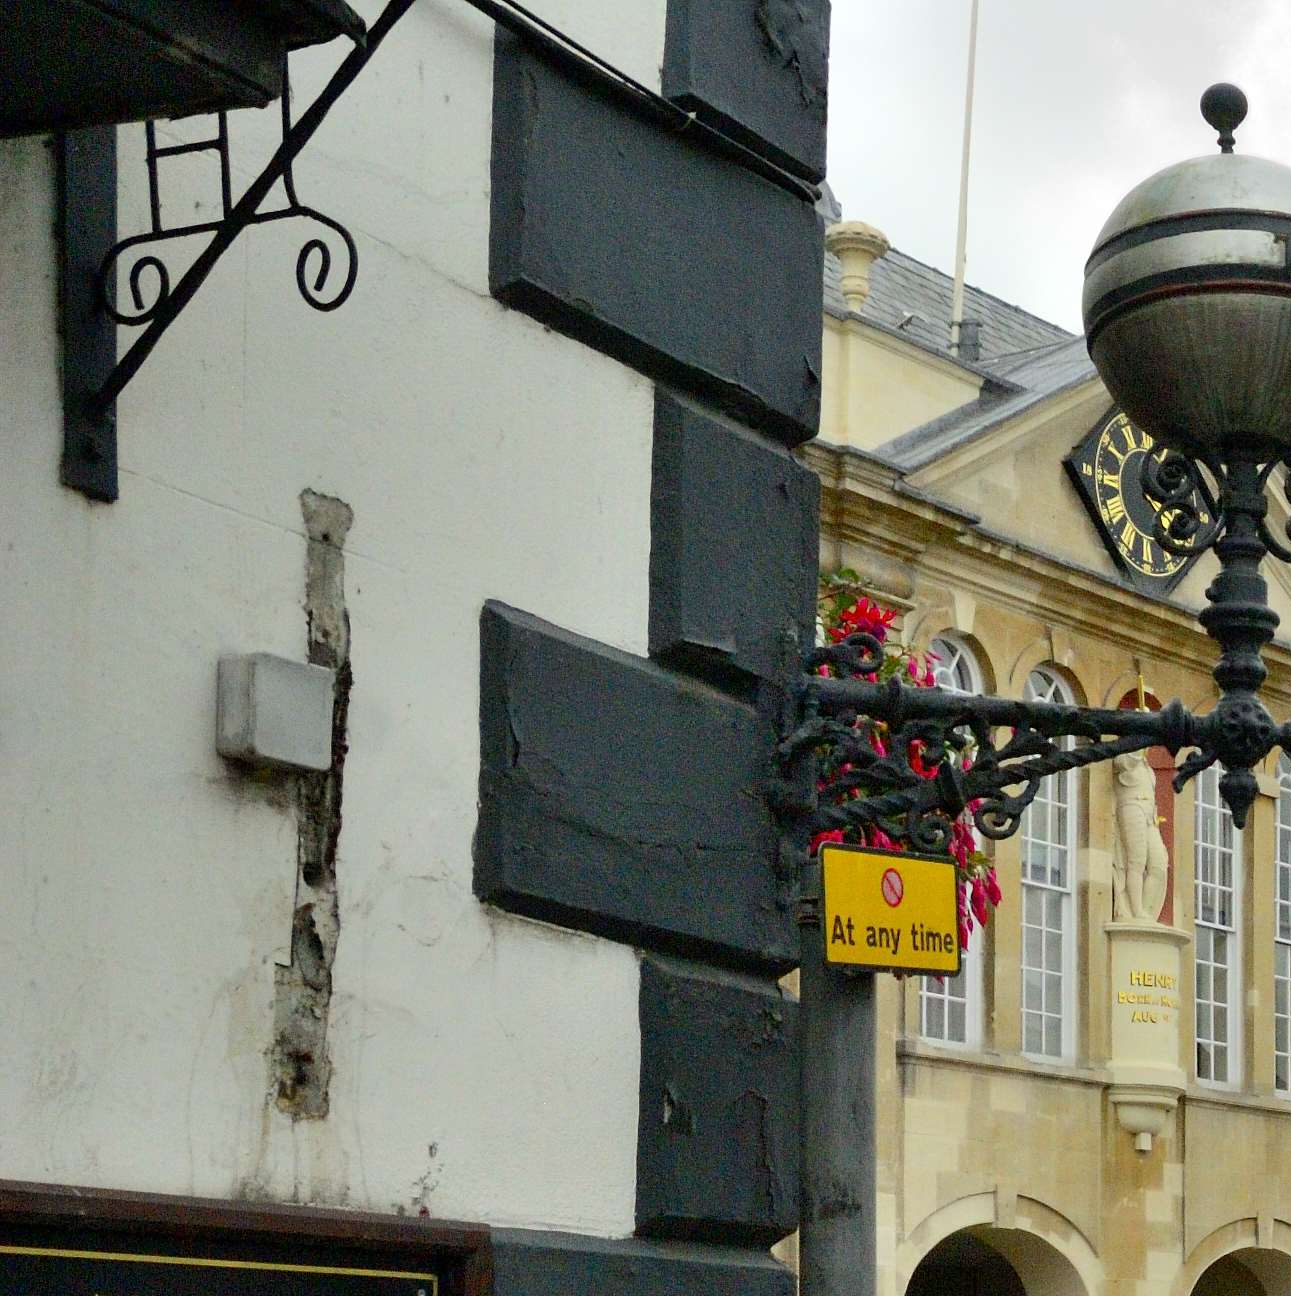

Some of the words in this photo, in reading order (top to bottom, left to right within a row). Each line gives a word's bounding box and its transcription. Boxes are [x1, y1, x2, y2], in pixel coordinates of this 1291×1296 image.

[831, 915, 855, 946] At
[865, 926, 900, 955] any
[911, 923, 954, 954] time
